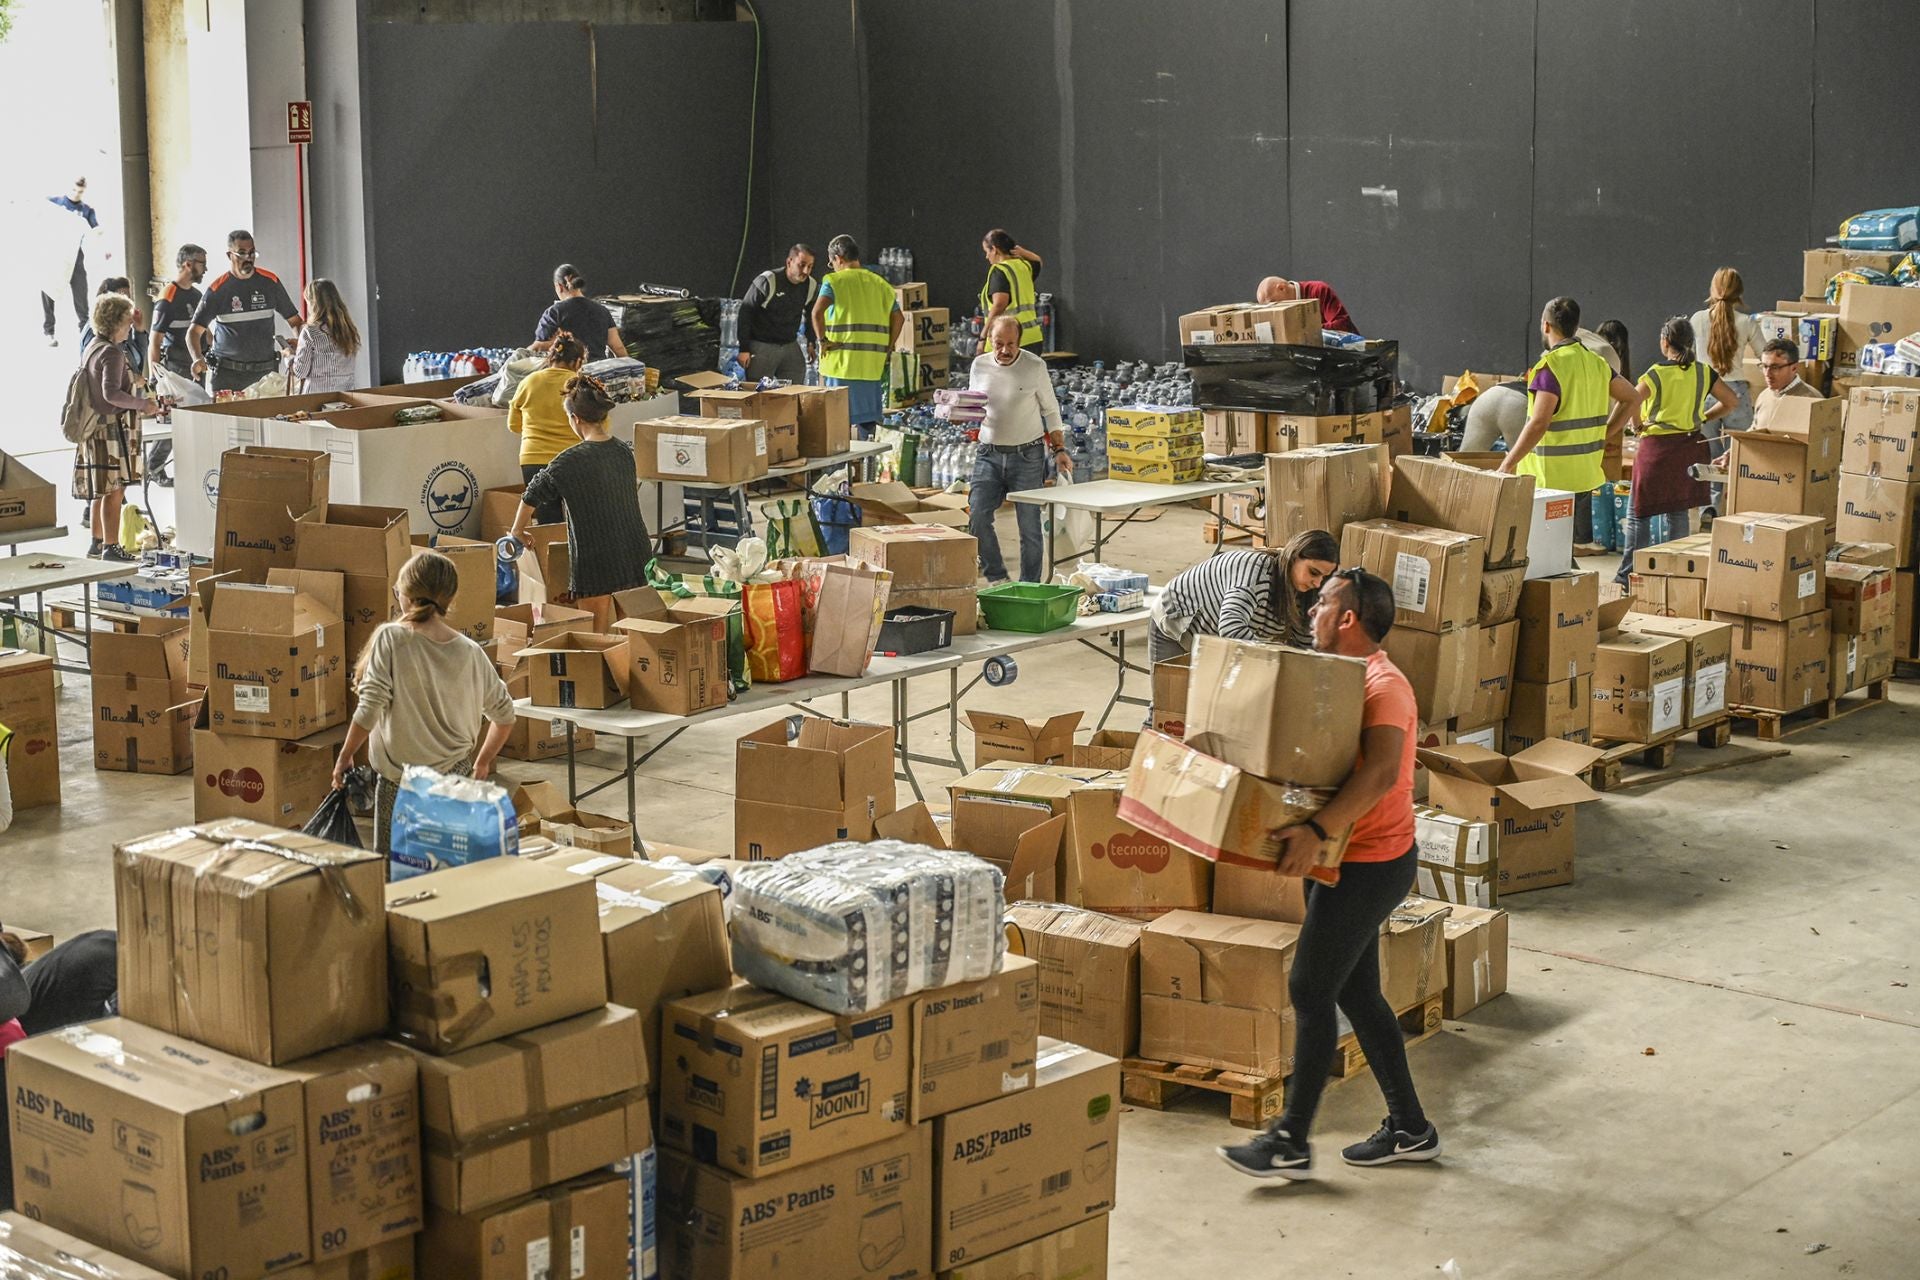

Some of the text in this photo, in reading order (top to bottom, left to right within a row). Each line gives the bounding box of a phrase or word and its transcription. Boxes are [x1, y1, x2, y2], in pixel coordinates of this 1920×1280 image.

[1869, 431, 1906, 452] Massilly
[1740, 464, 1780, 485] Massilly
[1845, 502, 1881, 521] Massilly
[226, 531, 276, 553] Massilly
[1718, 549, 1758, 571] Massilly
[217, 663, 264, 686] Massilly
[1735, 659, 1777, 682] Massilly
[101, 706, 144, 727] Massy
[220, 776, 263, 793] tecnocap
[1504, 817, 1548, 837] Massilly
[1111, 841, 1168, 858] tecnocap
[925, 992, 984, 1018] ABS Insert
[922, 1080, 936, 1094] 80
[16, 1086, 95, 1134] ABS Pants
[816, 1090, 865, 1119] LINDOR
[320, 1123, 361, 1144] Pants
[953, 1122, 1032, 1161] ABS Pants
[201, 1160, 246, 1183] Pants
[861, 1167, 874, 1185] M
[24, 1201, 41, 1222] 80
[740, 1183, 835, 1227] ABS Pants
[321, 1228, 347, 1250] 80
[950, 1247, 965, 1263] 80
